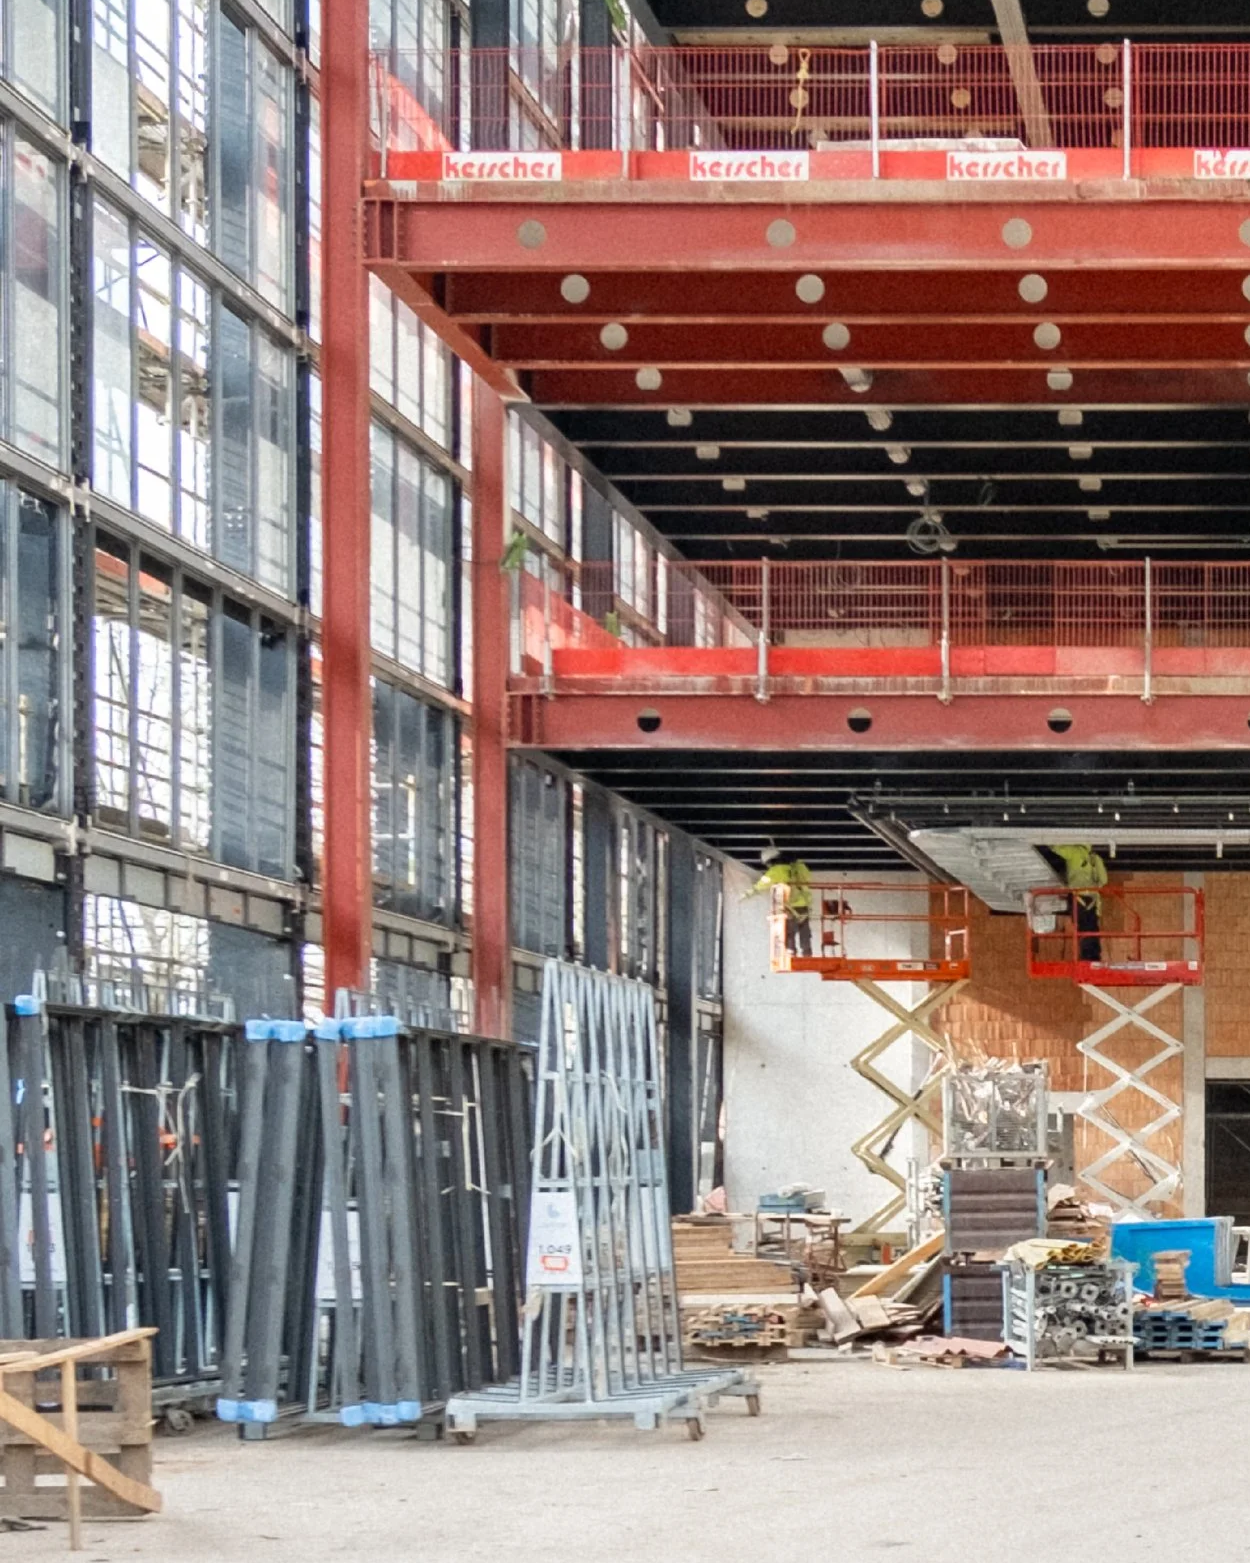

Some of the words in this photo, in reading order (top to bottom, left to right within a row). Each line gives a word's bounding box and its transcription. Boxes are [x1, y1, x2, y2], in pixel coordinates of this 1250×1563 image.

[445, 156, 554, 178] kerscher
[693, 155, 802, 178] kerscher
[949, 155, 1060, 177] kerscher
